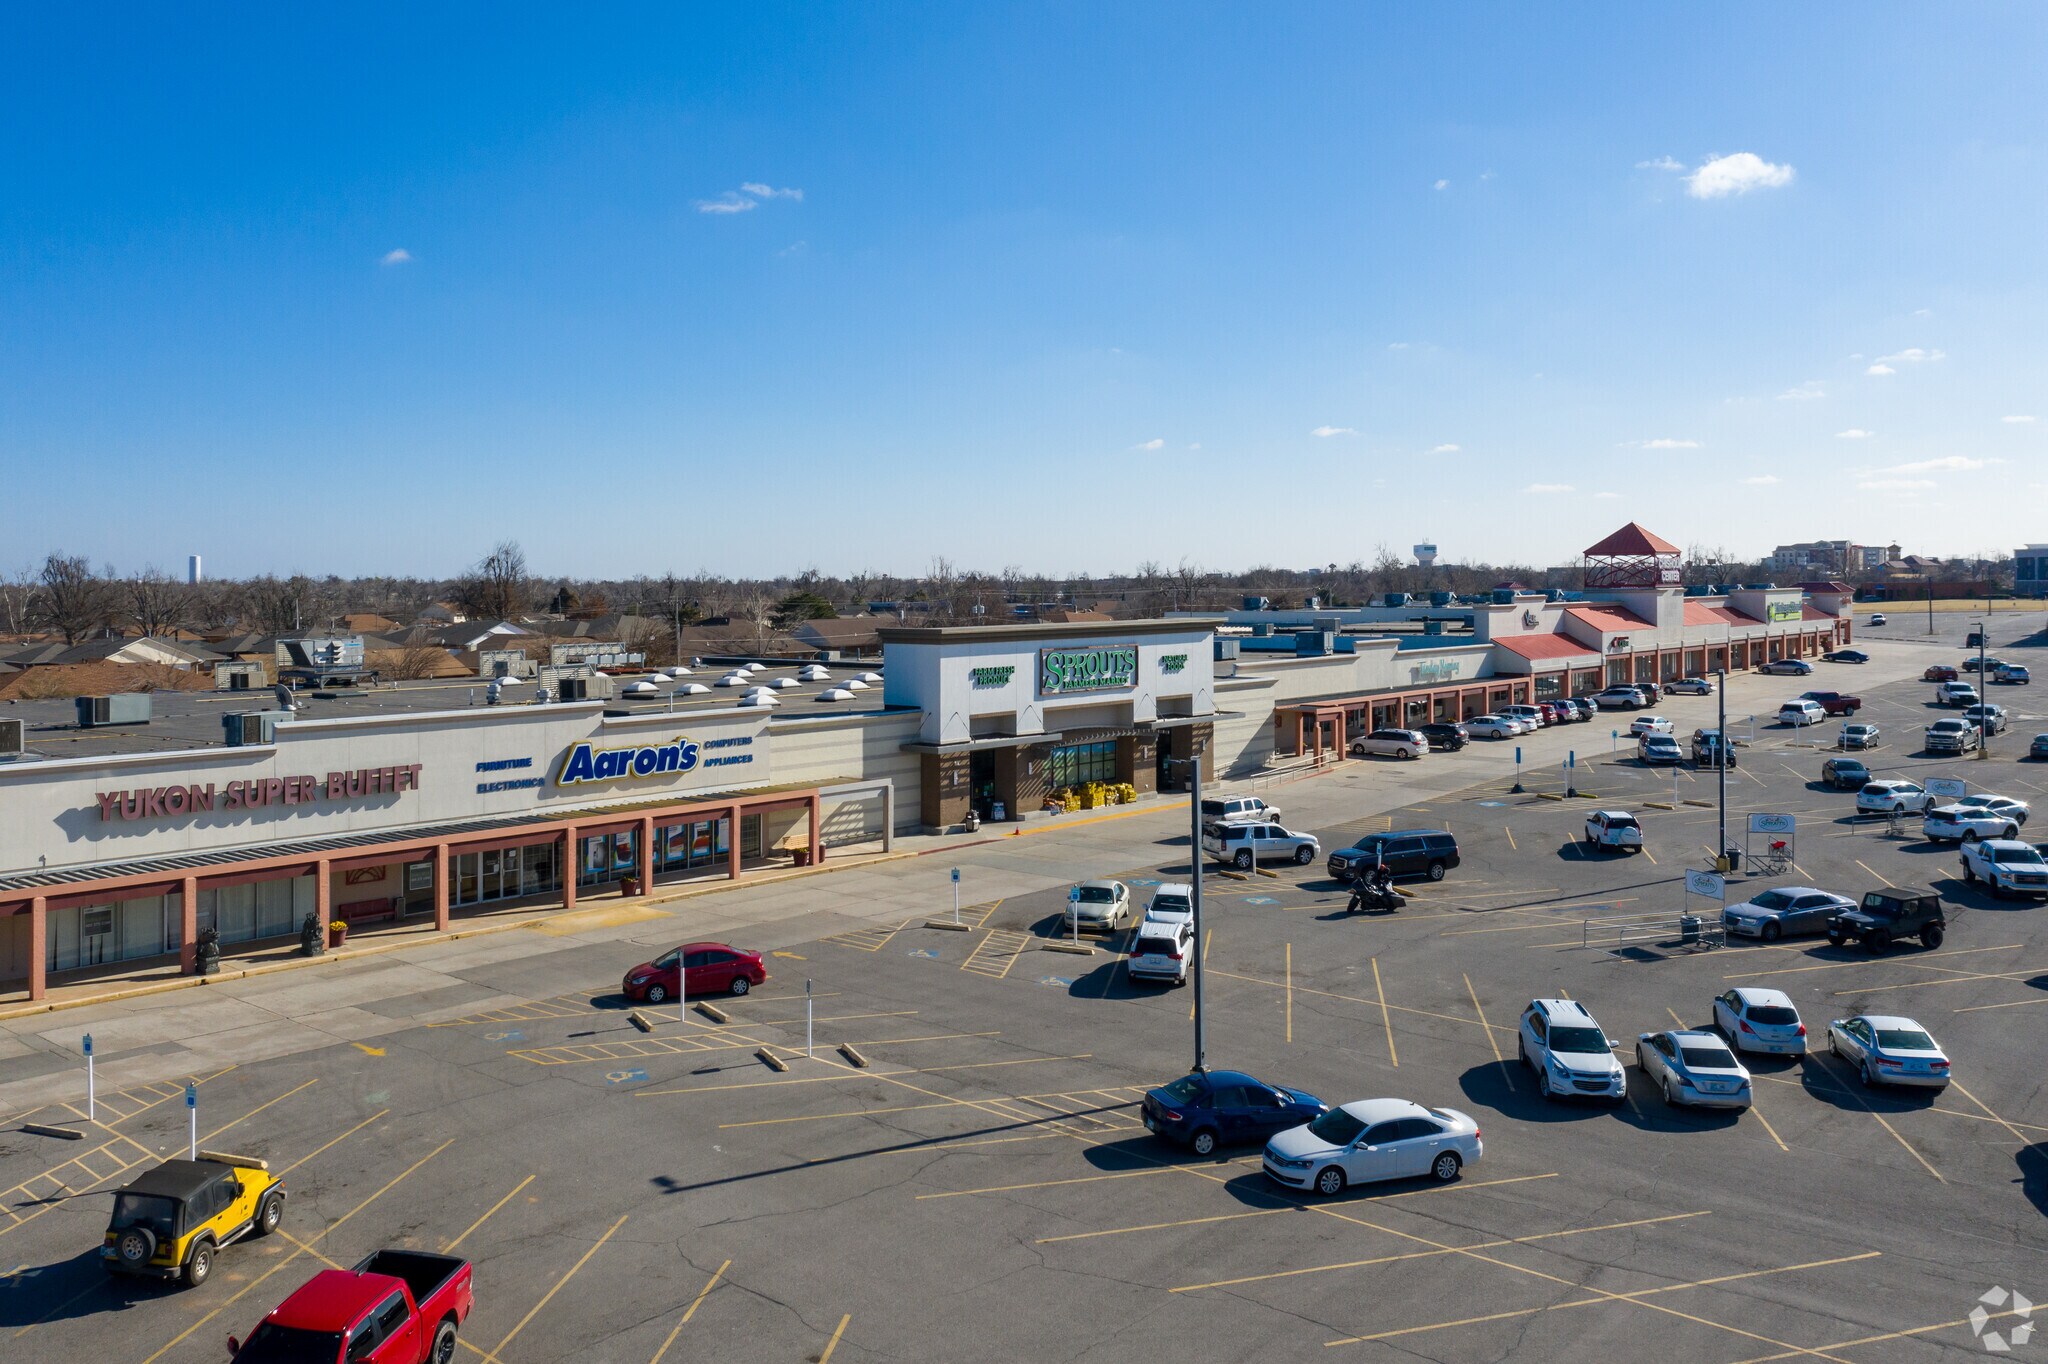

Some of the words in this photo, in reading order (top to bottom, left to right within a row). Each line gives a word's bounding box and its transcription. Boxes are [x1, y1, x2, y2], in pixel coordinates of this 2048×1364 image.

[1661, 570, 1680, 583] CENTER
[973, 667, 993, 676] FARM
[994, 666, 1015, 674] FRESH
[1045, 649, 1136, 688] SPROUTS
[1063, 678, 1099, 689] FARMERS
[1099, 676, 1129, 686] MARKET
[703, 736, 752, 750] COMPUTERS
[475, 757, 533, 772] FURNITURE
[557, 736, 700, 787] Aaron's
[703, 754, 753, 768] APPLIANCES
[95, 783, 214, 821] YUKON
[225, 775, 316, 811] SUPER
[327, 764, 423, 799] BUFFET
[476, 777, 545, 794] ELECTRONICS
